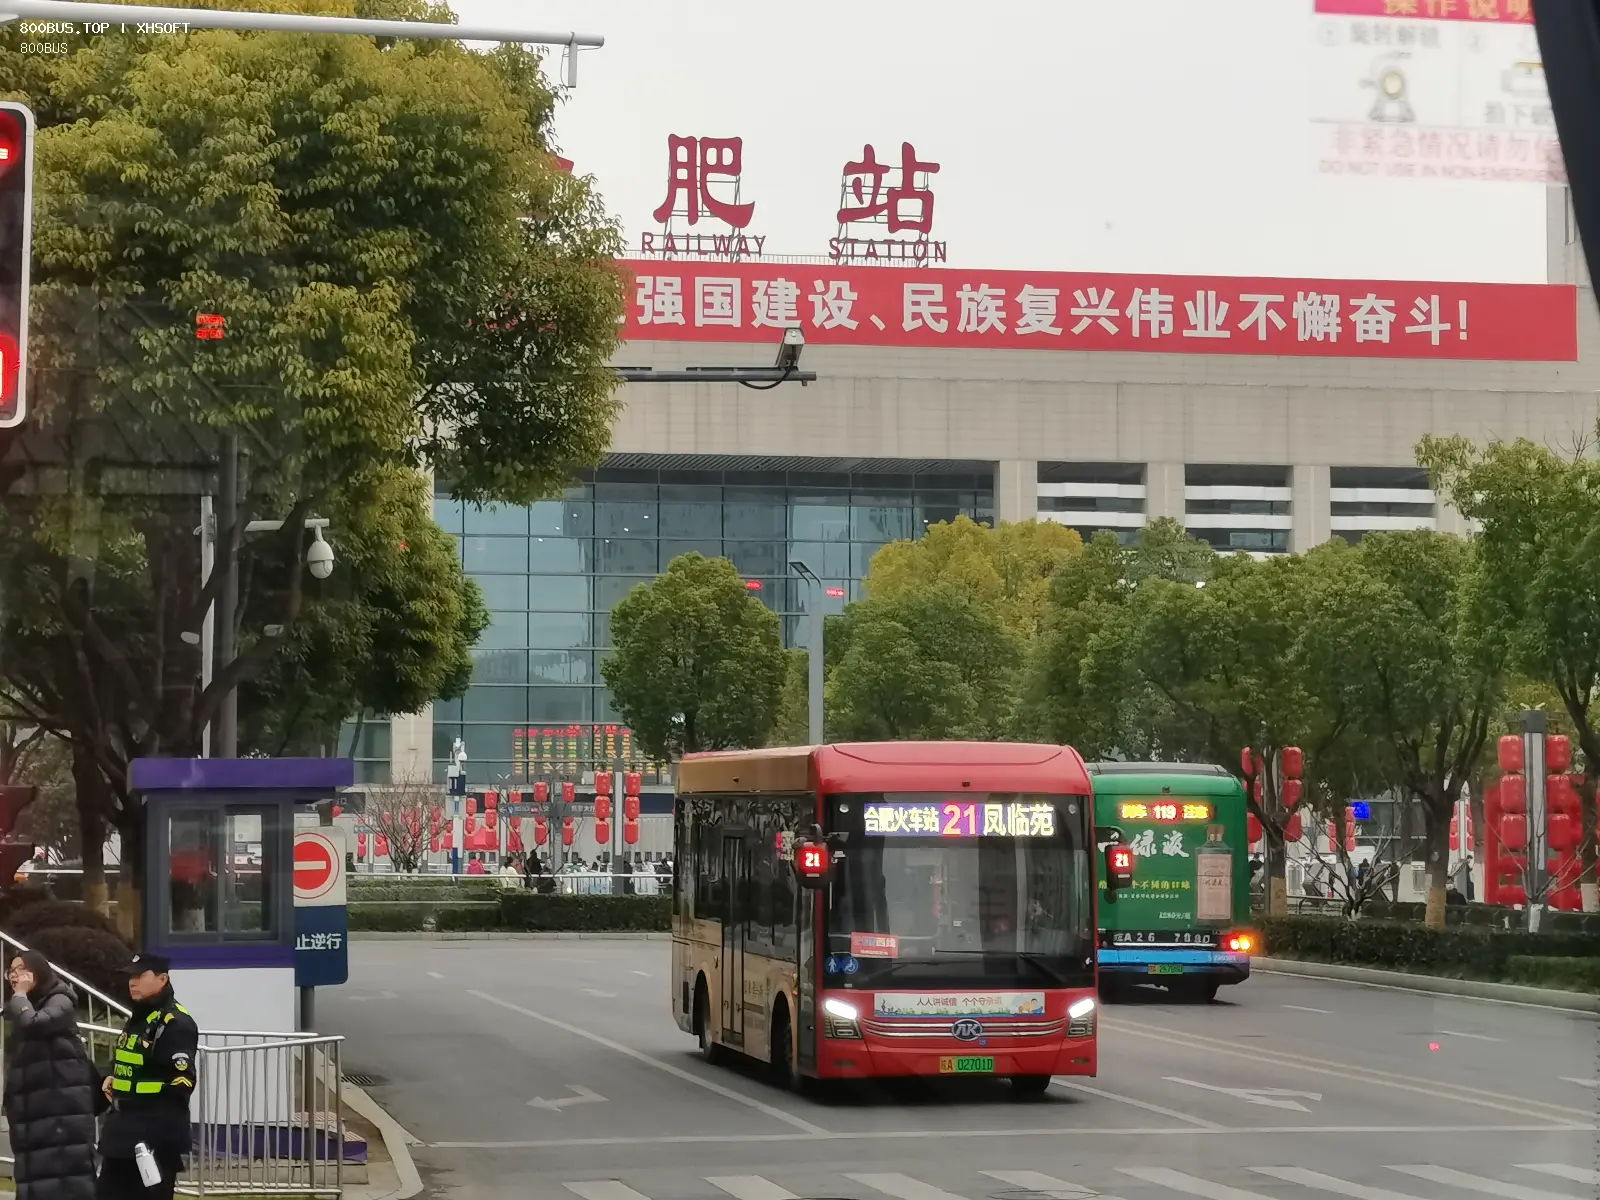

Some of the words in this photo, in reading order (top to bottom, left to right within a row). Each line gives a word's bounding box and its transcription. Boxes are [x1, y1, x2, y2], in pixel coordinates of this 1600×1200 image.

[653, 134, 755, 228] 肥
[837, 141, 940, 234] 站
[641, 232, 766, 257] RAILWAY
[829, 237, 947, 262] STATION
[623, 275, 1468, 346] 强国建设、民族复兴伟业不懈奋斗!
[864, 806, 939, 832] 合肥火车站
[942, 804, 976, 834] 21
[983, 804, 1054, 836] 凤临苑
[1153, 804, 1176, 819] 119
[805, 852, 820, 867] 21
[1114, 853, 1129, 868] 21
[295, 933, 342, 950] 止逆行
